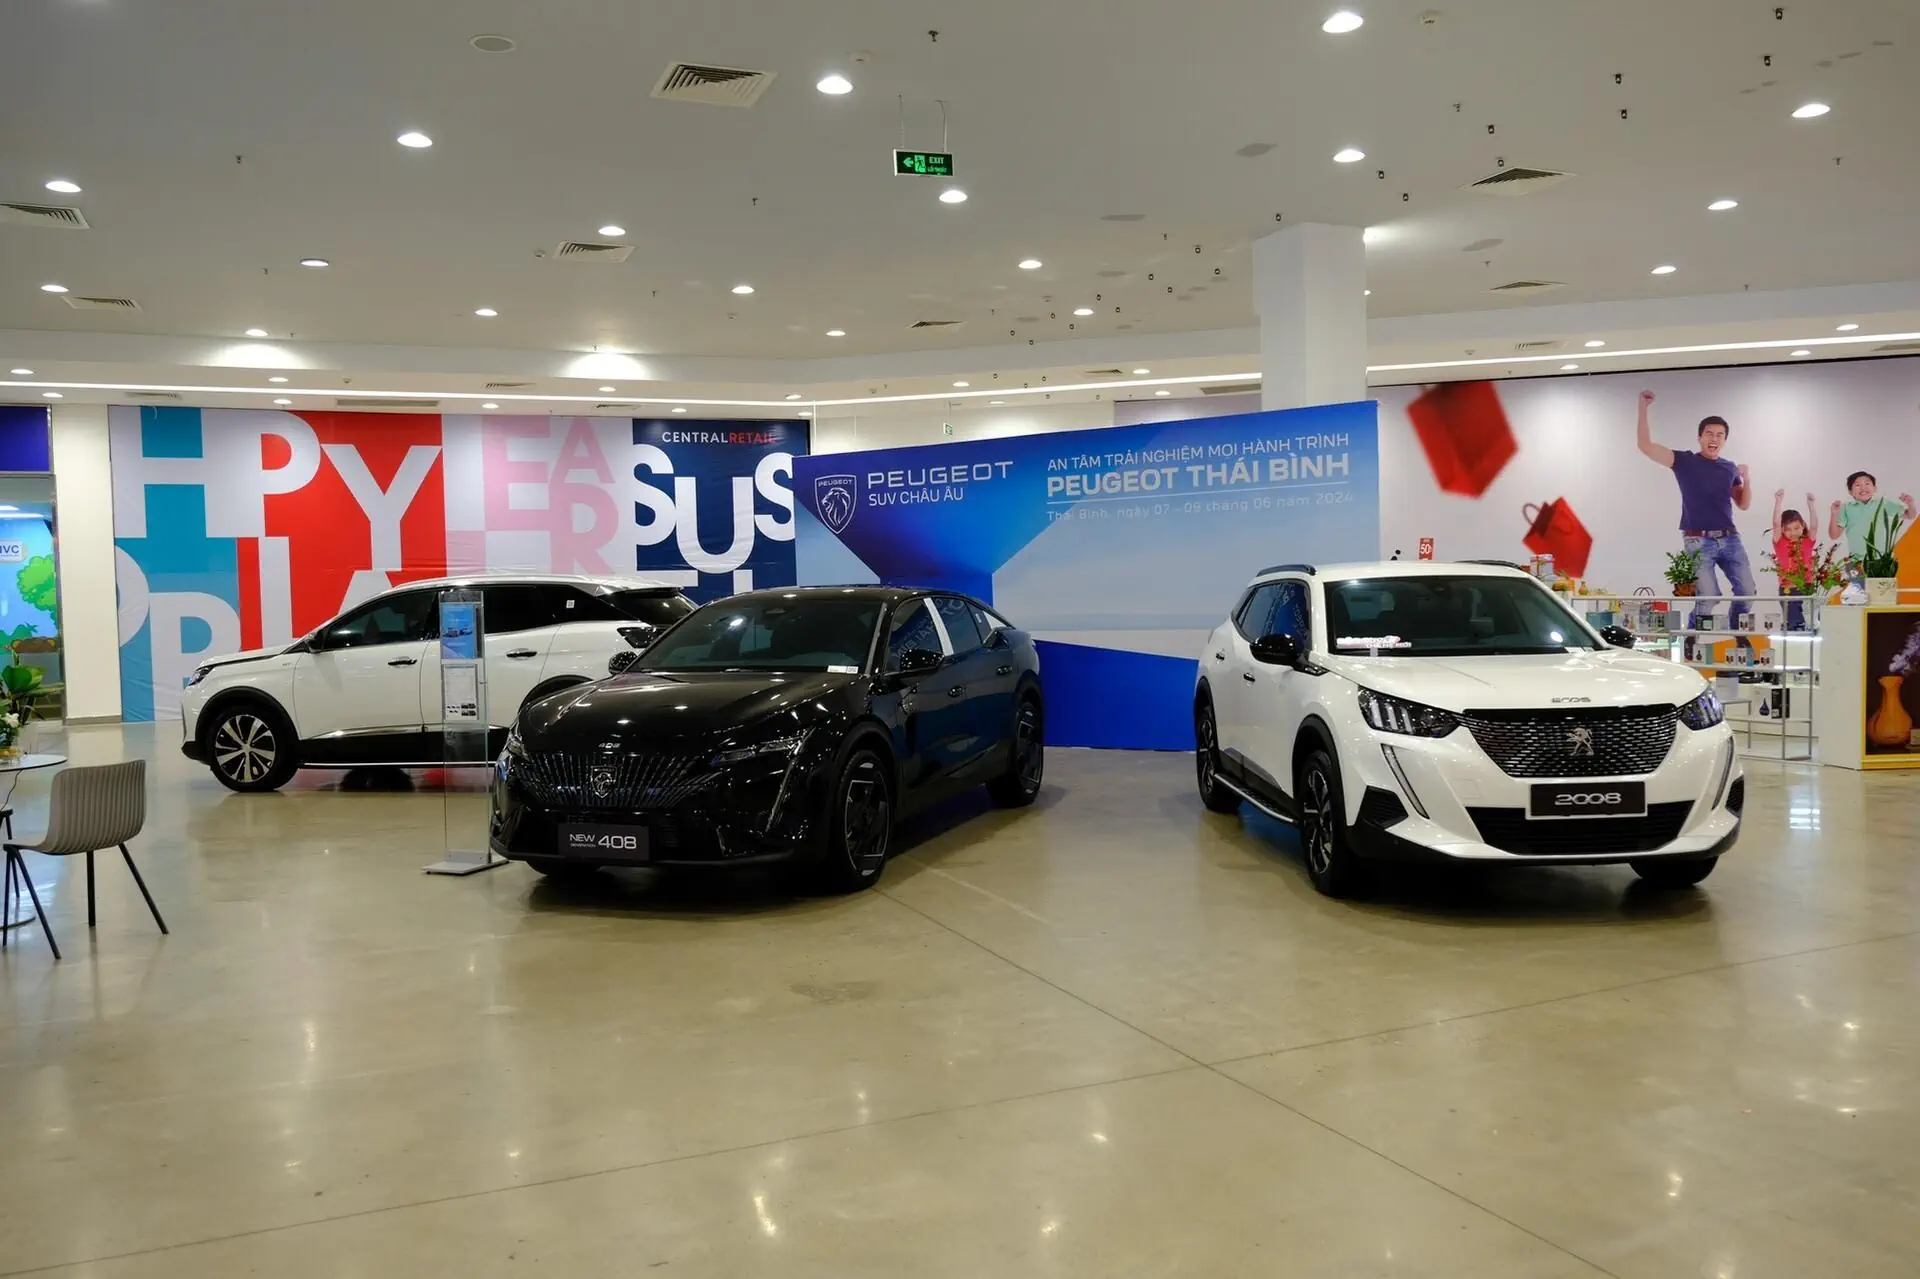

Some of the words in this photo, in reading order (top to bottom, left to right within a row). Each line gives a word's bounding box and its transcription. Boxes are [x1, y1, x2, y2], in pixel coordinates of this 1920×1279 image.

[929, 156, 944, 164] EXIT
[1047, 457, 1068, 471] AN
[1072, 454, 1101, 468] TÂM
[1104, 449, 1138, 466] TRẢI
[1143, 445, 1203, 463] NGHIỆM
[1242, 438, 1290, 455] HÀNH
[1295, 432, 1349, 449] TRÌNH
[818, 478, 852, 487] PEUGEOT
[867, 461, 1014, 489] PEUGEOT
[1047, 467, 1179, 497] PEUGEOT
[1186, 456, 1260, 488] THÁI
[1269, 452, 1349, 482] BÌNH
[869, 492, 896, 506] SUV
[899, 487, 940, 505] CHÂU
[943, 486, 964, 501] ÂU
[1154, 503, 1170, 515] 07
[1254, 497, 1271, 509] 06
[1315, 491, 1354, 505] 2024
[1555, 792, 1622, 805] 2008
[569, 833, 596, 842] NEW
[598, 835, 637, 849] 408
